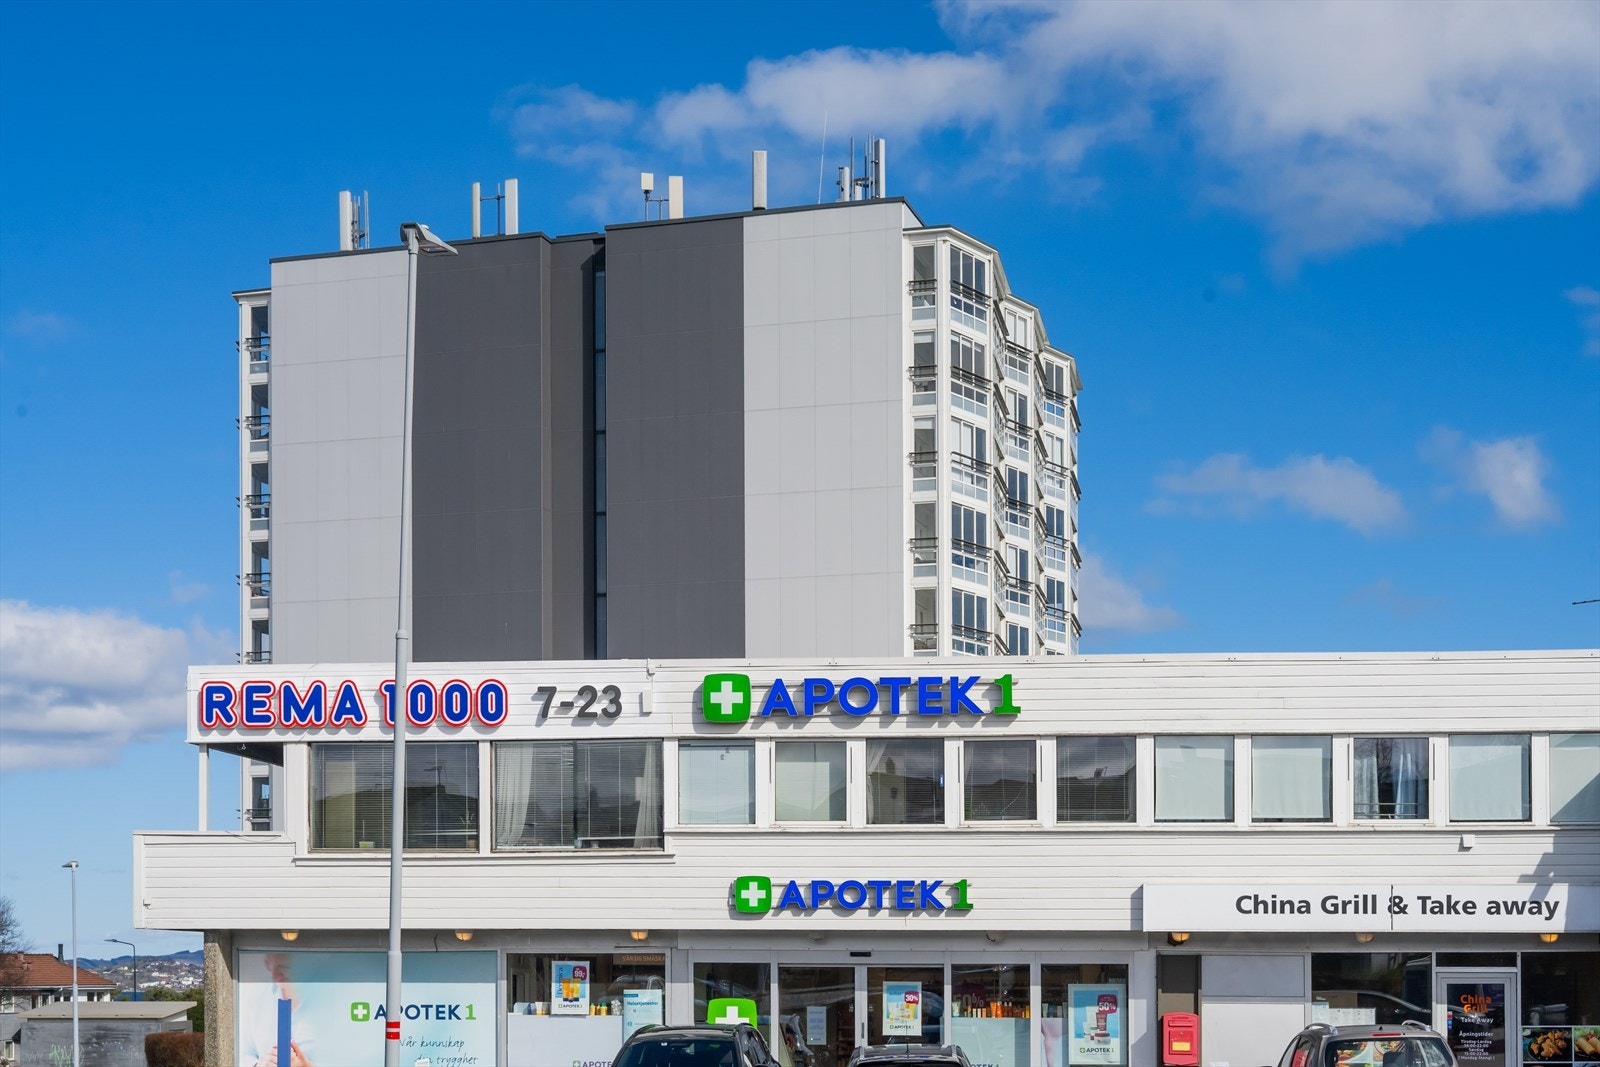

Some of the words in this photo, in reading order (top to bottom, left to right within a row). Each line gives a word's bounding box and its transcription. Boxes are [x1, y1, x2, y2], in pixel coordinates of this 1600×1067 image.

[201, 680, 368, 728] REMA
[378, 678, 508, 727] 1000
[537, 684, 623, 719] 7-23
[761, 676, 986, 717] APOTEK
[993, 673, 1022, 715] 1
[778, 879, 947, 909] APOTEK
[953, 879, 974, 909] 1
[1235, 894, 1311, 915] China
[1321, 894, 1377, 915] Grill
[1387, 895, 1409, 915] &
[1416, 894, 1477, 915] Take
[1486, 900, 1560, 921] away
[905, 994, 919, 1002] 30%
[1460, 994, 1492, 1004] China
[374, 1004, 462, 1020] AOTEK
[465, 1004, 476, 1020] 1
[1098, 1002, 1117, 1011] 50%
[1464, 1004, 1489, 1013] Grill
[420, 1036, 465, 1052] kunnskap
